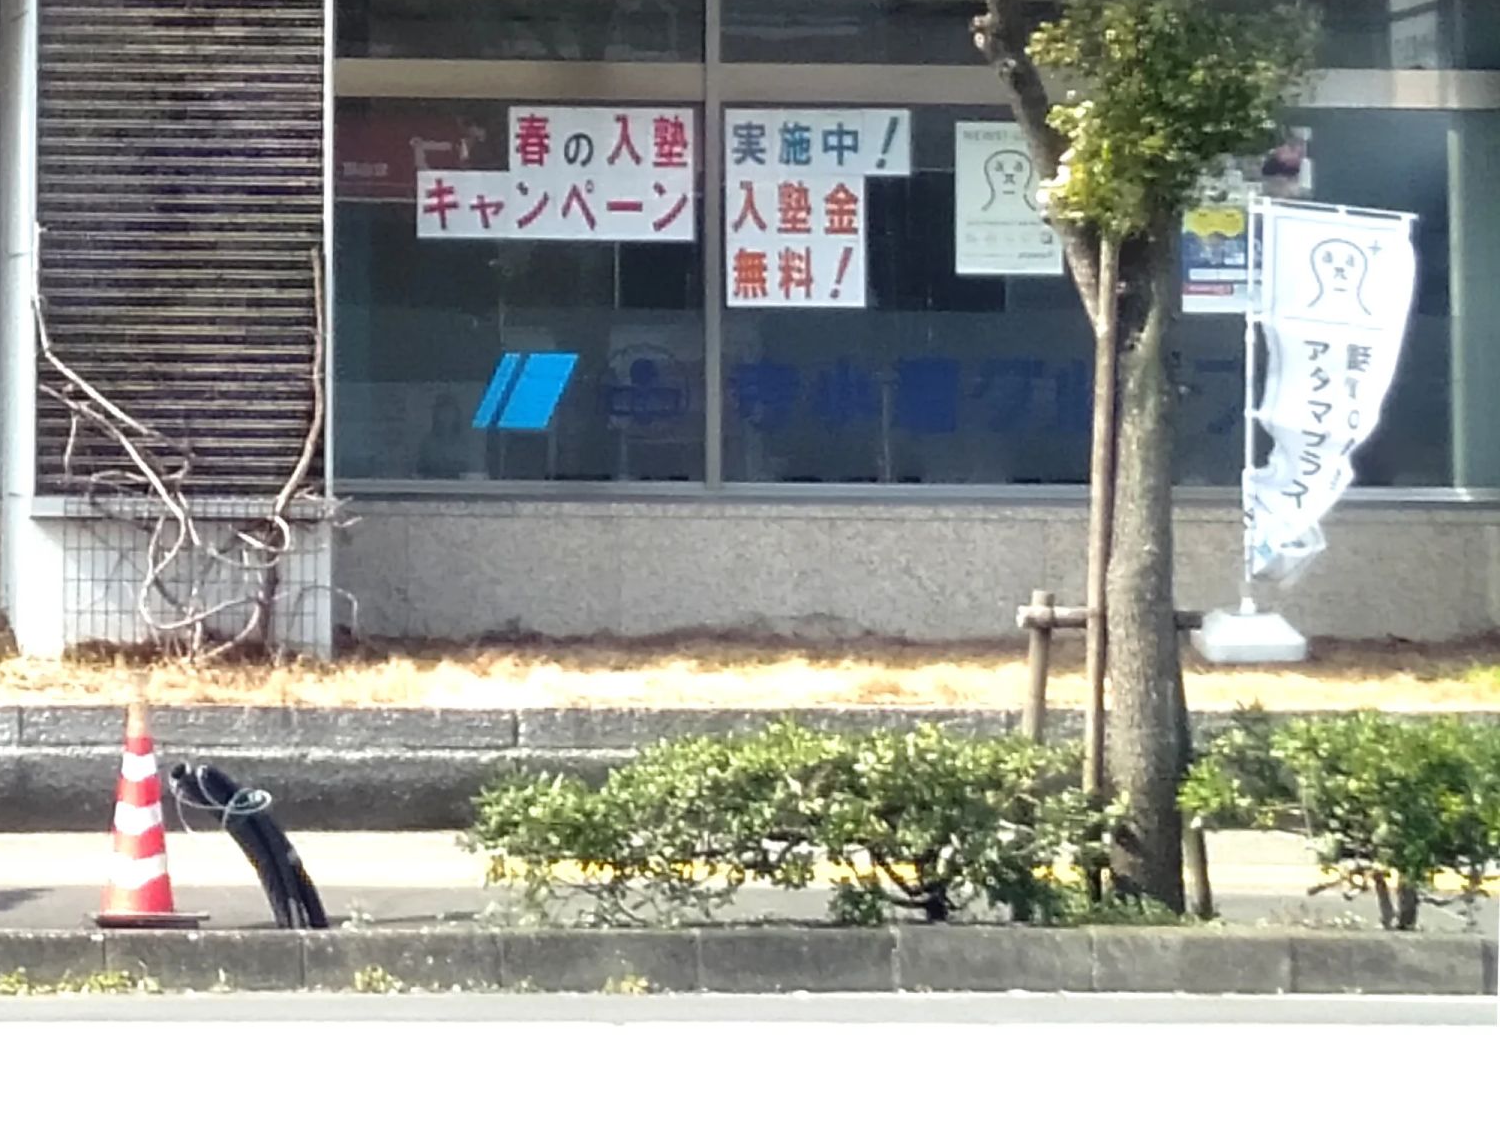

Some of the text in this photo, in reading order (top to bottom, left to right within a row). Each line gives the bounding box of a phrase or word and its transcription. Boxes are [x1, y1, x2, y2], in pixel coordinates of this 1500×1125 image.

[515, 113, 688, 168] 春の入塾
[731, 116, 900, 170] 実施中!
[422, 178, 688, 232] キャンペーン
[731, 180, 860, 235] 入塾金
[732, 246, 854, 301] 無料!
